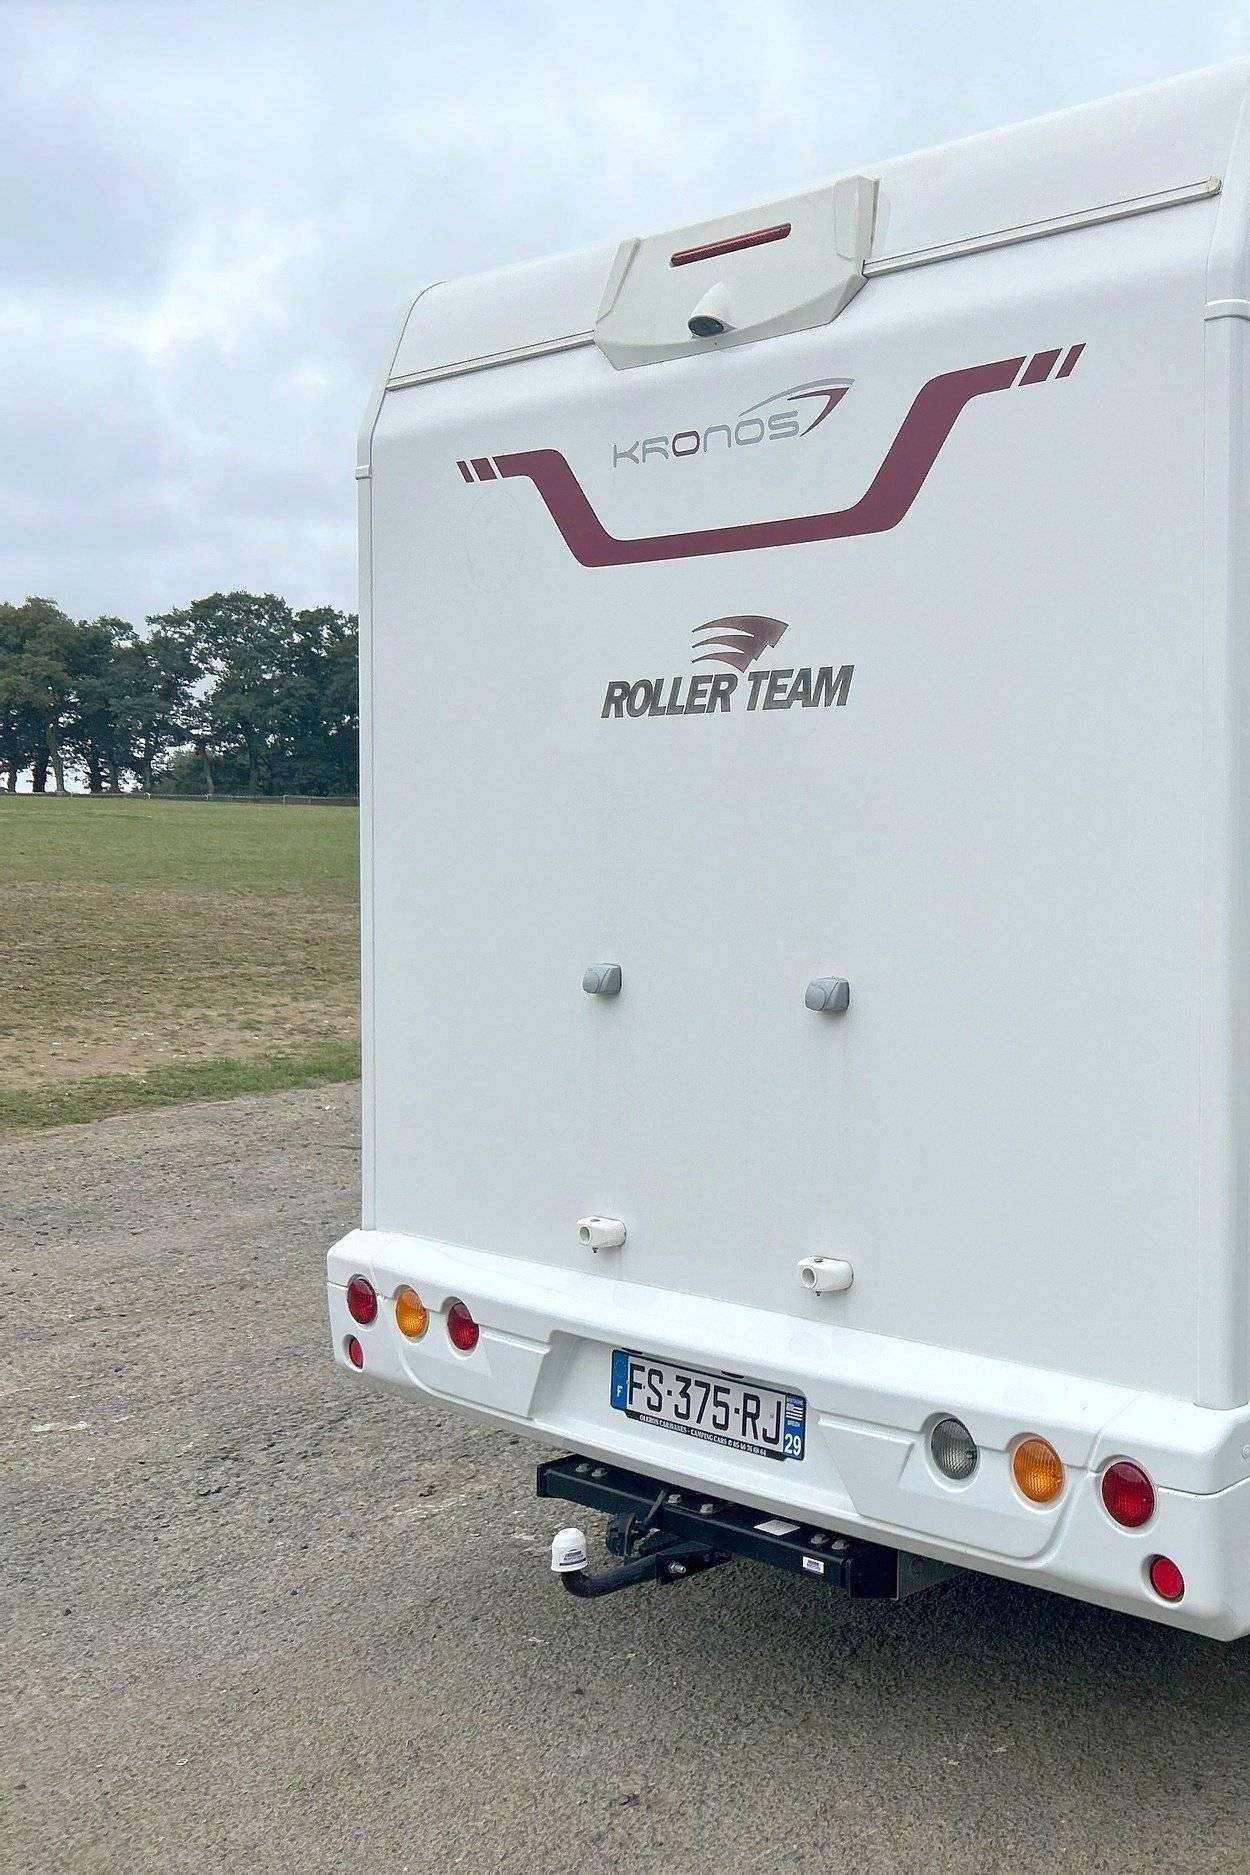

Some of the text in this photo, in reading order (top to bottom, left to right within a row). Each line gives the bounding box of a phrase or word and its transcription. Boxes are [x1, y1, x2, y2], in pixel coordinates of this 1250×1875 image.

[612, 409, 801, 469] KRONOS
[600, 664, 856, 719] ROLLER TEAM
[616, 1385, 623, 1398] F
[784, 1433, 802, 1456] 29
